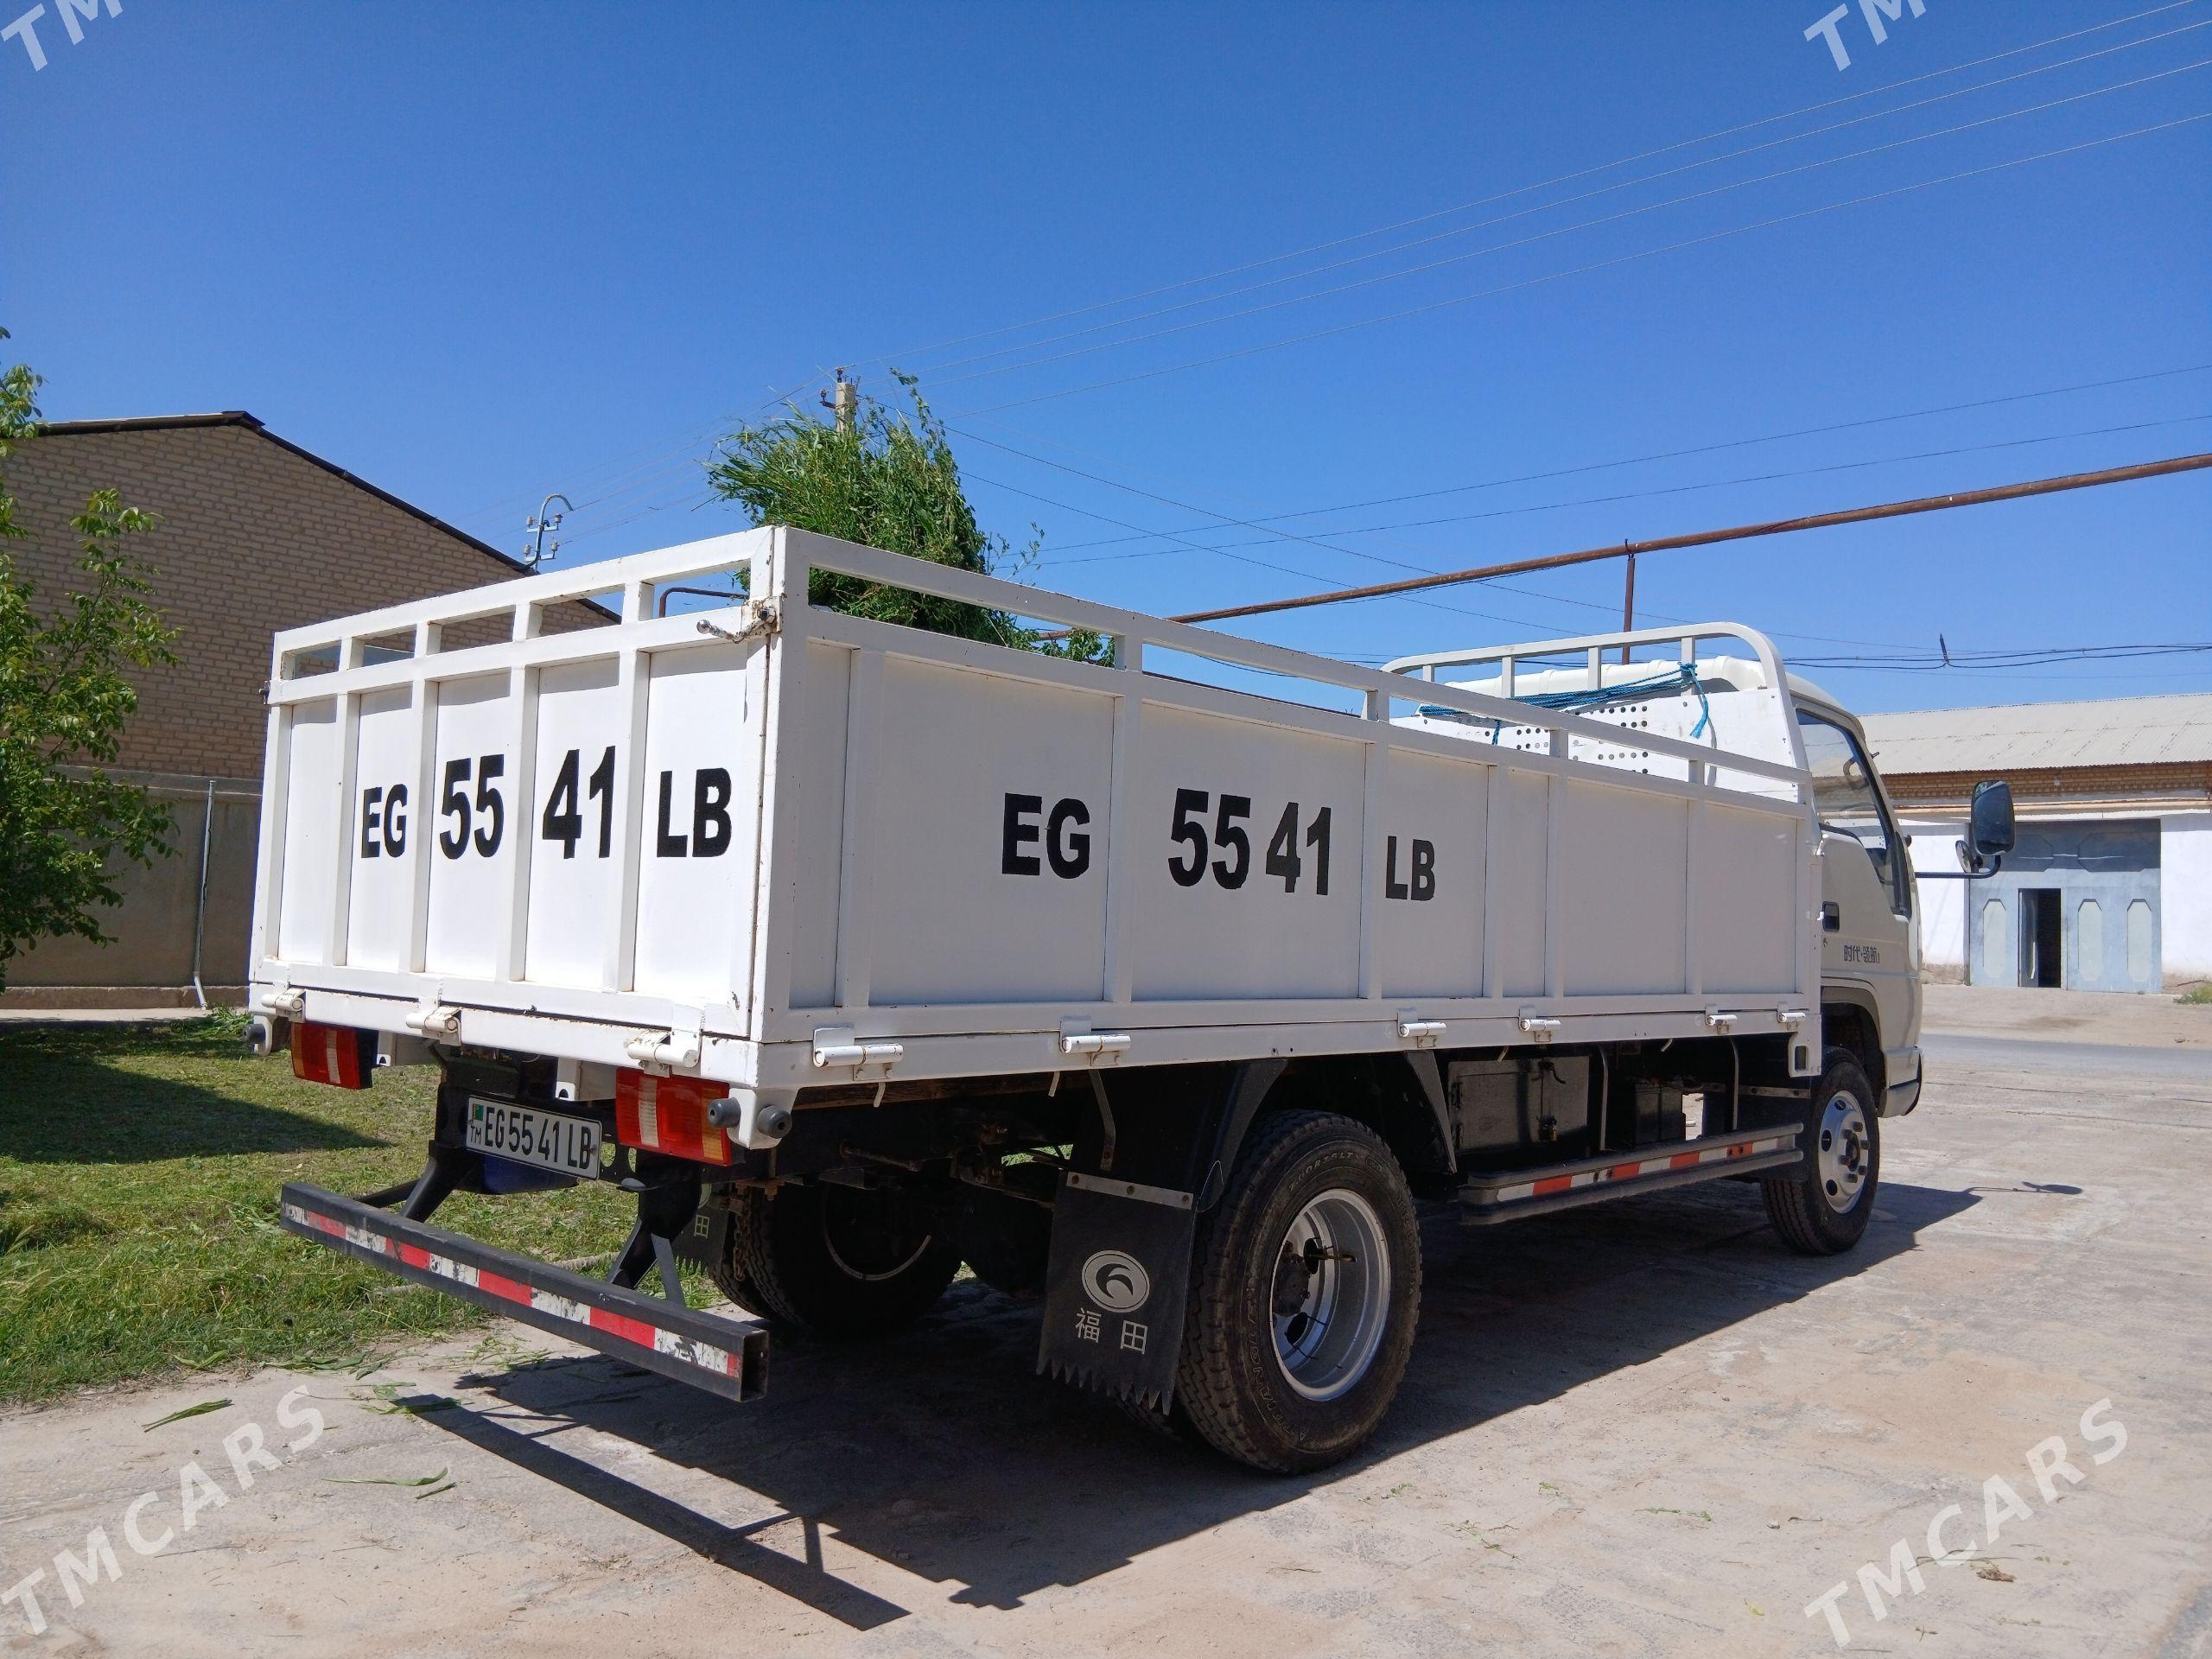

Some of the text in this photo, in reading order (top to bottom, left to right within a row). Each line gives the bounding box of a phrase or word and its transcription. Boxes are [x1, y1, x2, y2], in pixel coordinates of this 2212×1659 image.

[360, 746, 732, 861] EG 55 41 LB
[1001, 792, 1090, 880] EG
[1385, 835, 1436, 901] LB
[470, 1125, 482, 1145] TM
